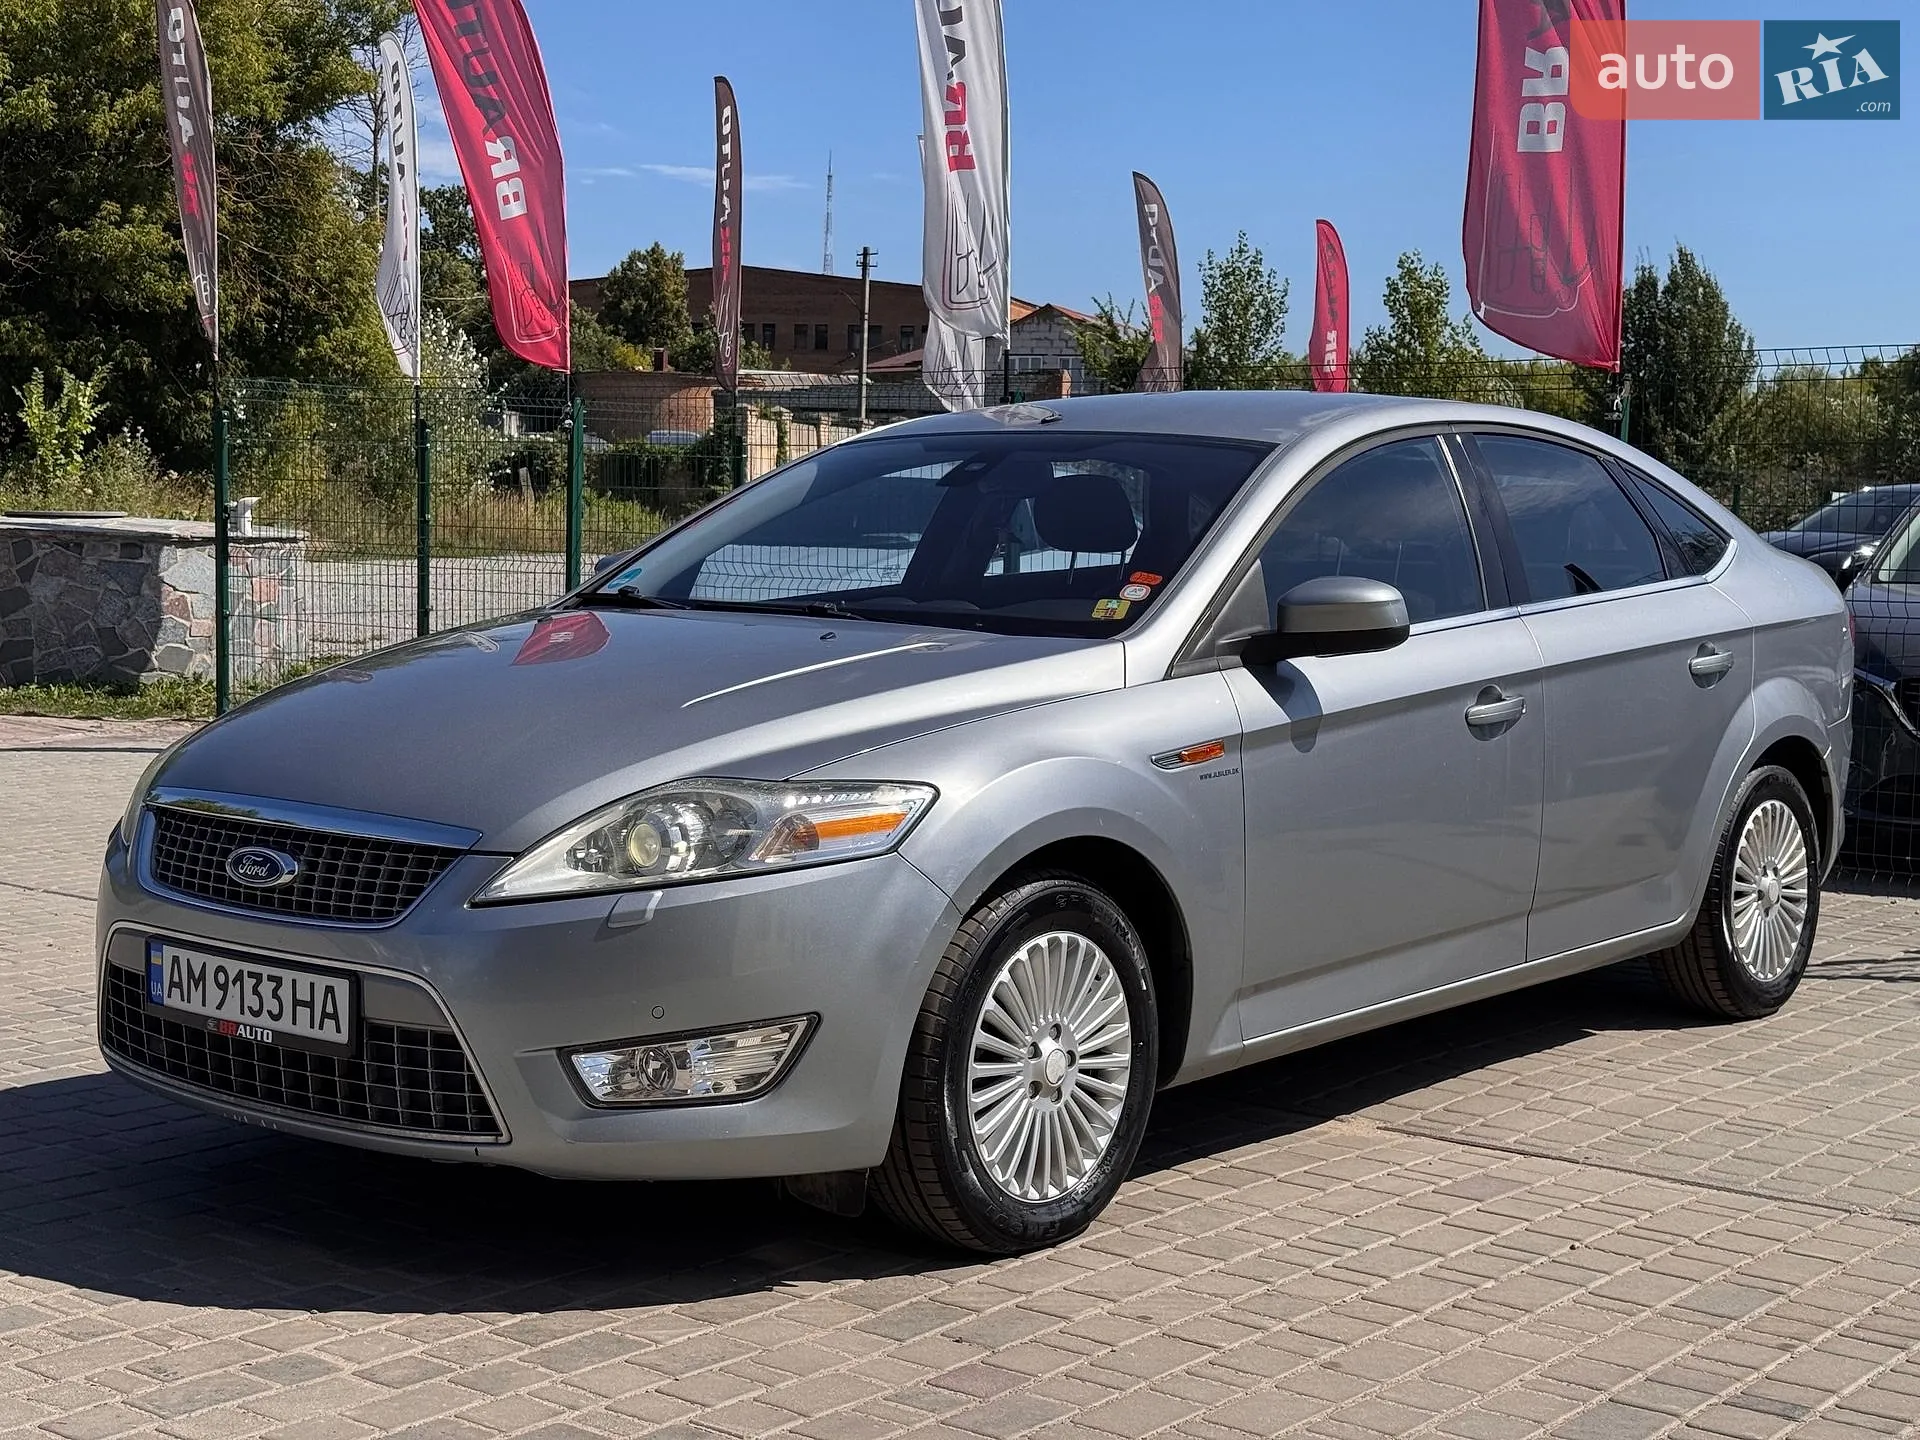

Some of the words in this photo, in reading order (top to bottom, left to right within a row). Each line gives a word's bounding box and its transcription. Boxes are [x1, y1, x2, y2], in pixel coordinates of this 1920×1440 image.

[238, 854, 271, 877] Ford
[150, 980, 164, 996] UA
[167, 955, 207, 1008] AM
[213, 964, 284, 1022] 9133
[291, 978, 342, 1035] HA
